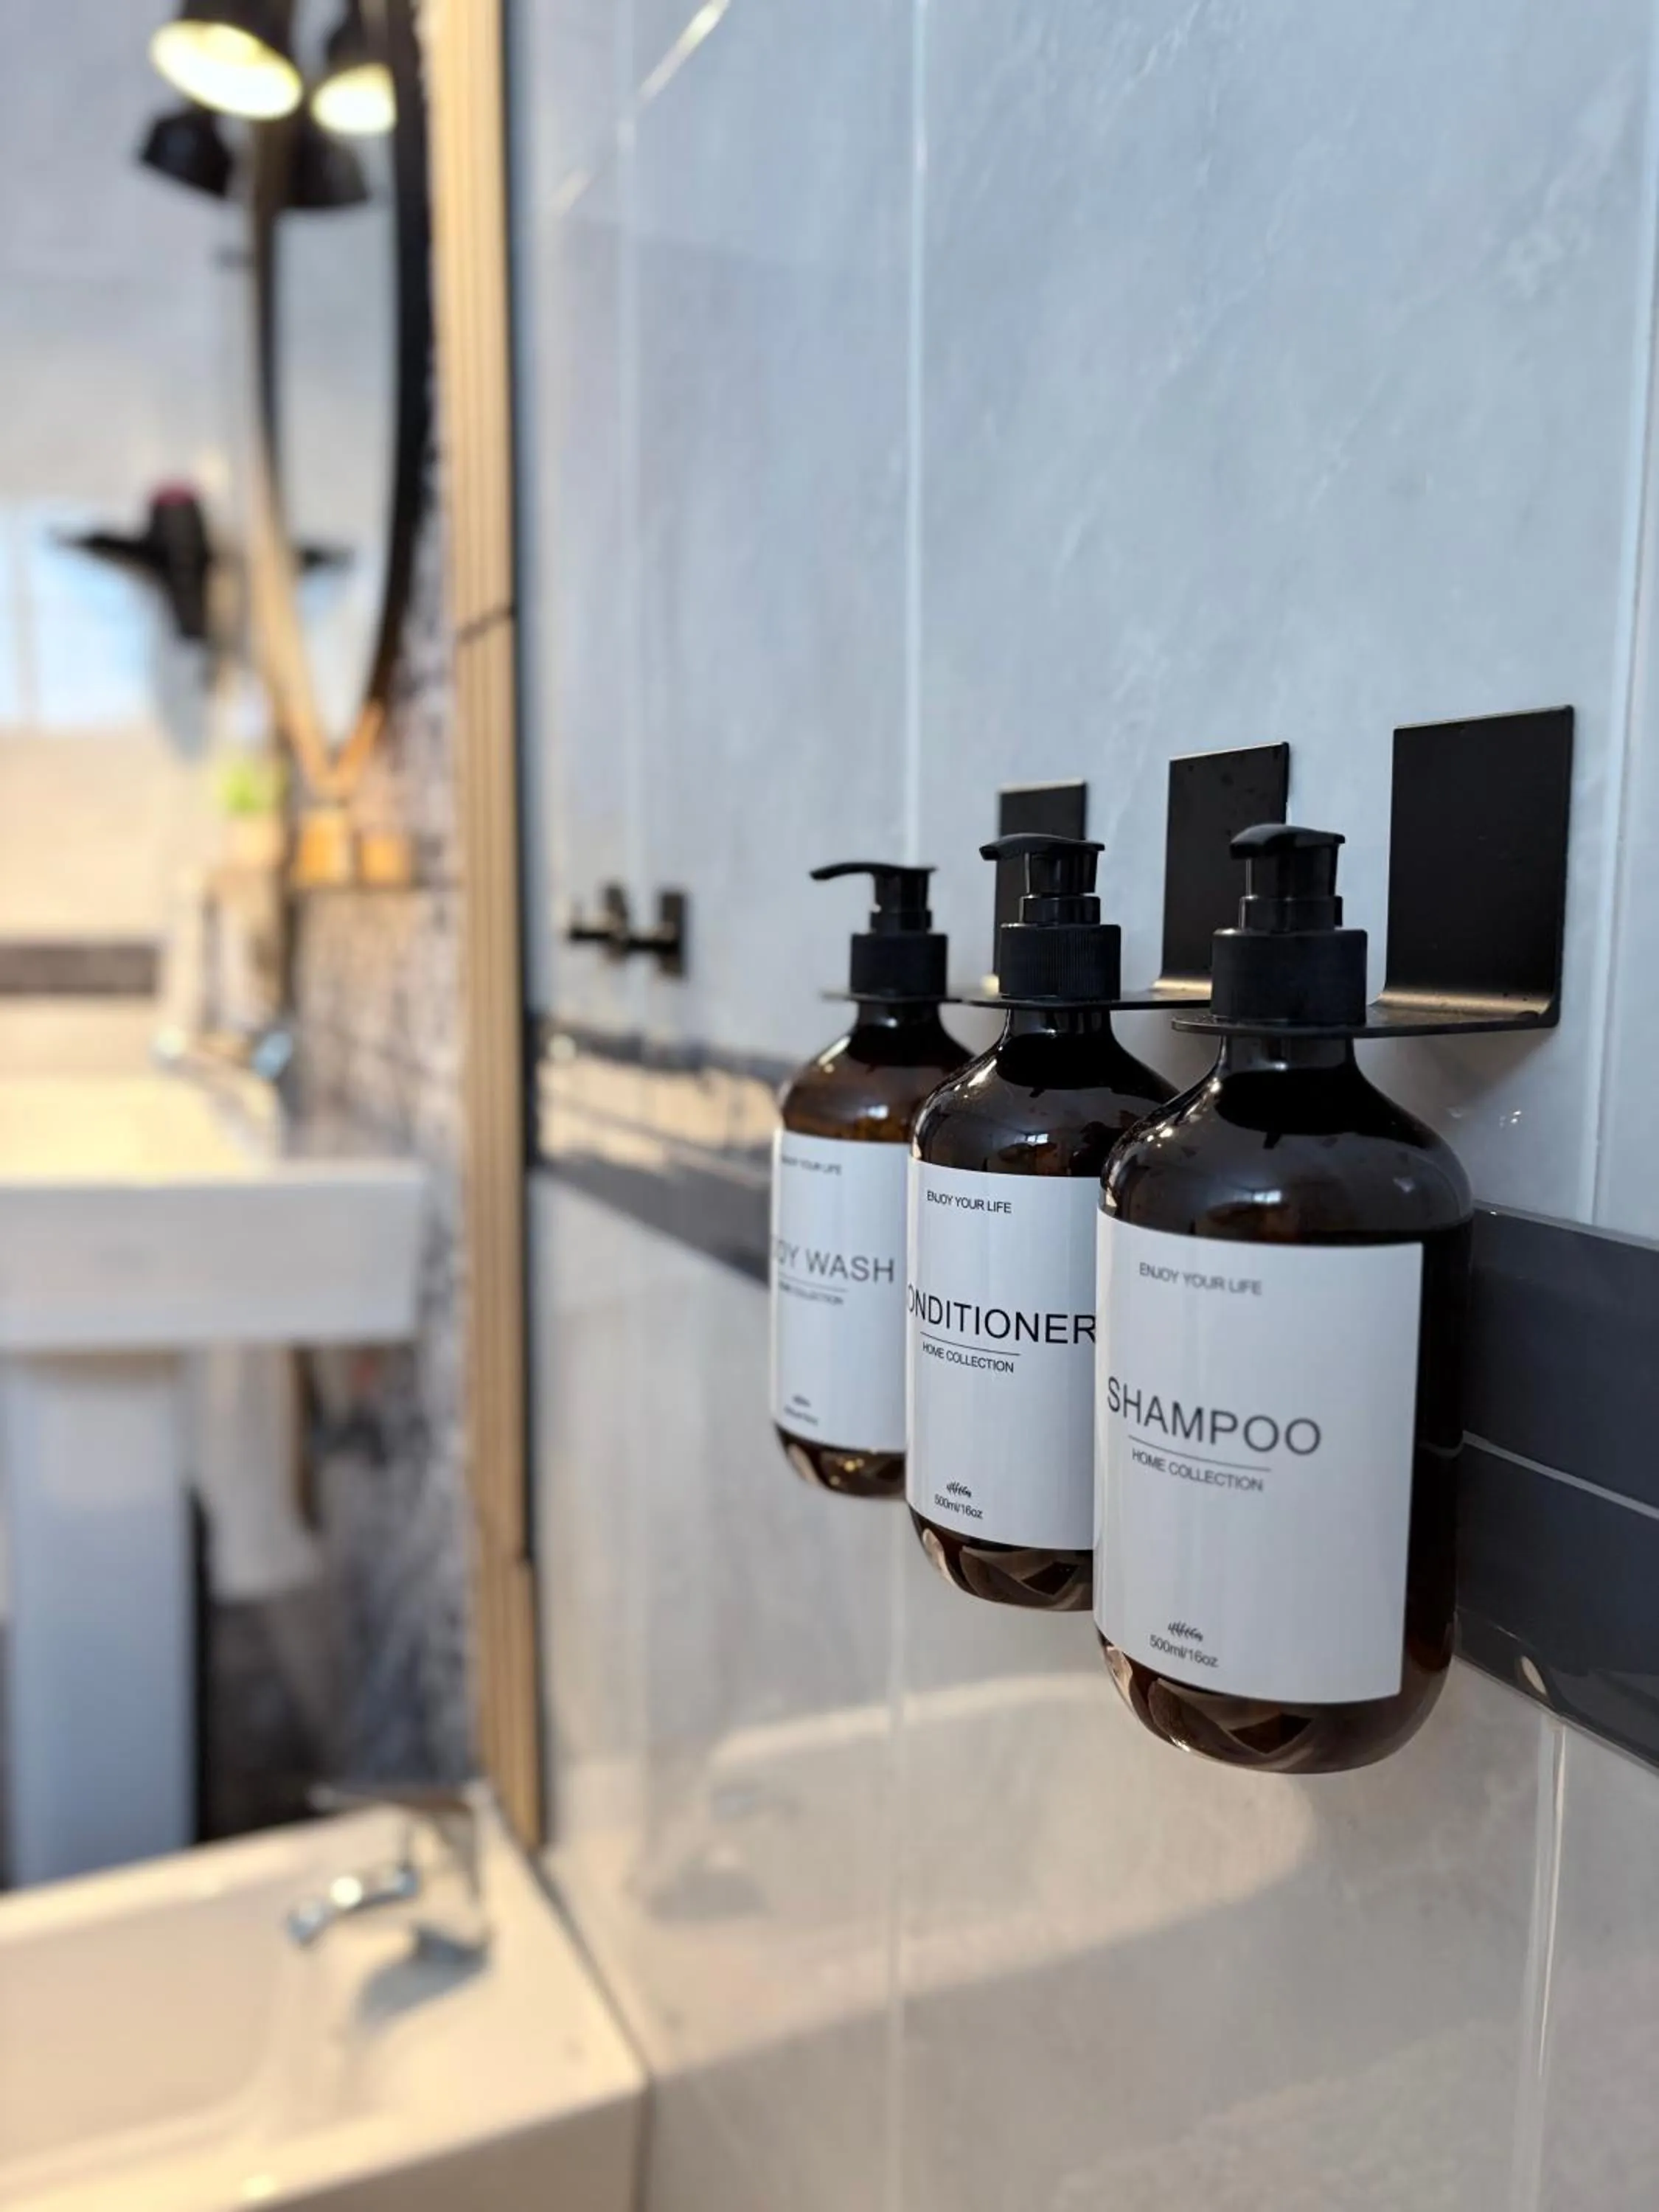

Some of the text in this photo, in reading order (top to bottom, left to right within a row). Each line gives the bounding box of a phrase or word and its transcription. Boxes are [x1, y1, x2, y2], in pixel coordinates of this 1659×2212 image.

[927, 1189, 1012, 1214] ENJOY YOUR LIFE
[804, 1248, 894, 1284] WASH
[1139, 1262, 1262, 1295] ENJOY YOUR LIFE
[908, 1283, 1096, 1344] ONDITIONER
[922, 1341, 1015, 1373] HOME COLLECTION
[1107, 1376, 1321, 1456] SHAMPOO
[1132, 1447, 1264, 1492] HOME COLLECTION
[934, 1493, 984, 1519] 500ml/16oz
[1150, 1634, 1220, 1668] 500ml/16oz
